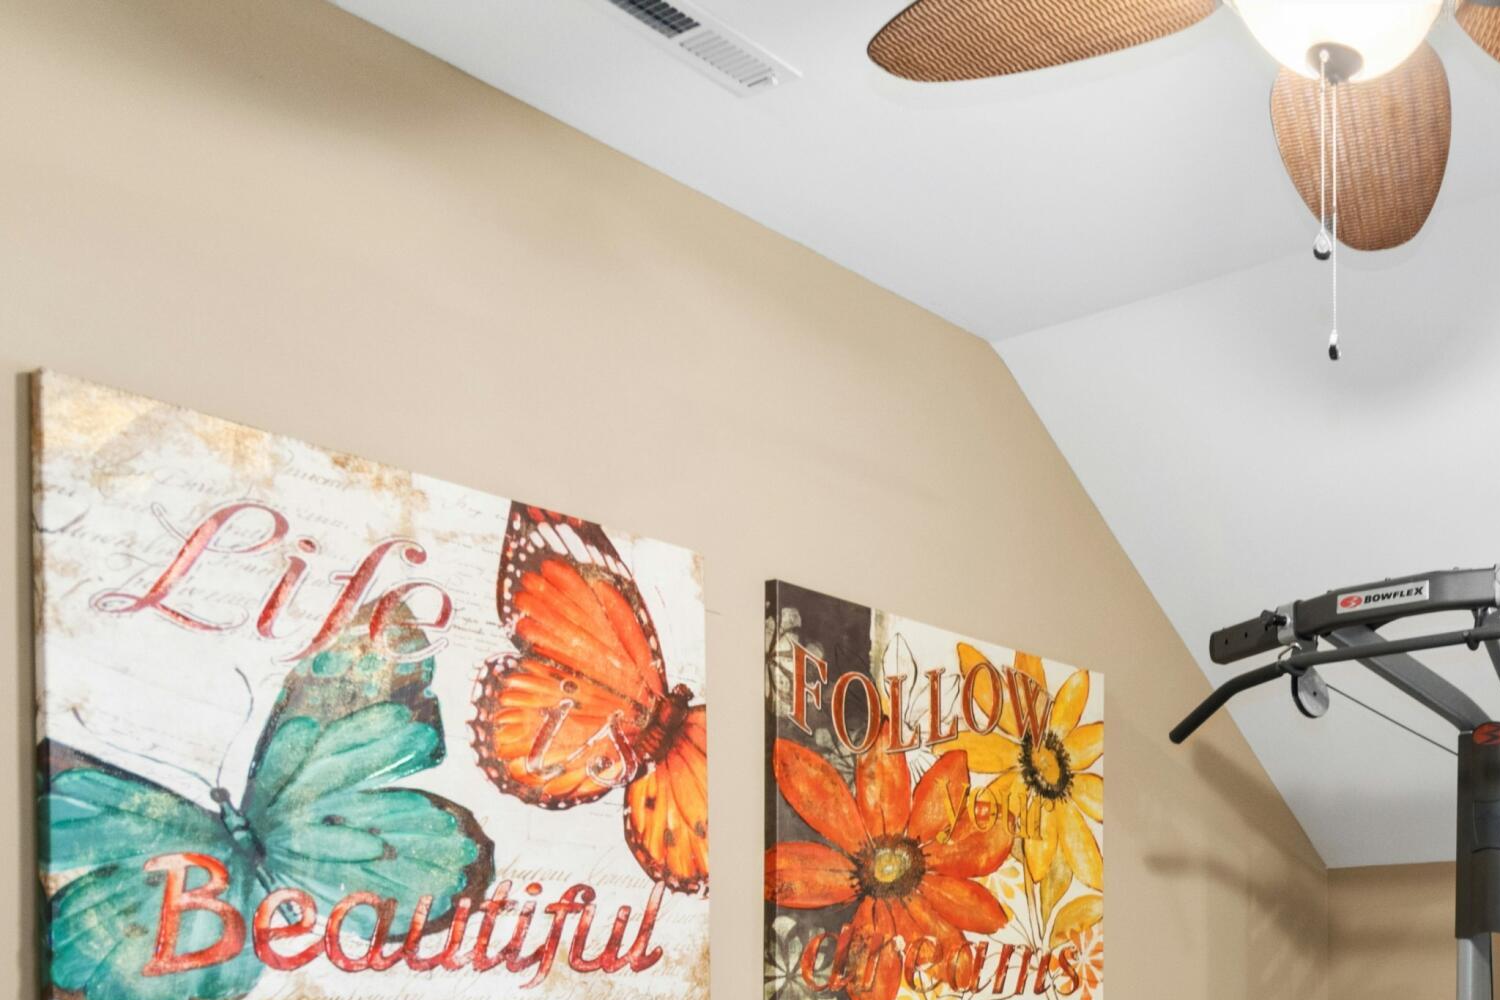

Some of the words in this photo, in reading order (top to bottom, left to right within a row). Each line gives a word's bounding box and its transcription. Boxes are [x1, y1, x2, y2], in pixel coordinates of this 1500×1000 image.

[90, 500, 454, 663] Life
[1364, 586, 1423, 604] BOWFLEX
[524, 678, 639, 789] is
[787, 641, 1056, 755] FOLLOW
[935, 777, 1056, 845] your
[143, 851, 663, 989] Beautiful
[801, 924, 1080, 996] dreams
